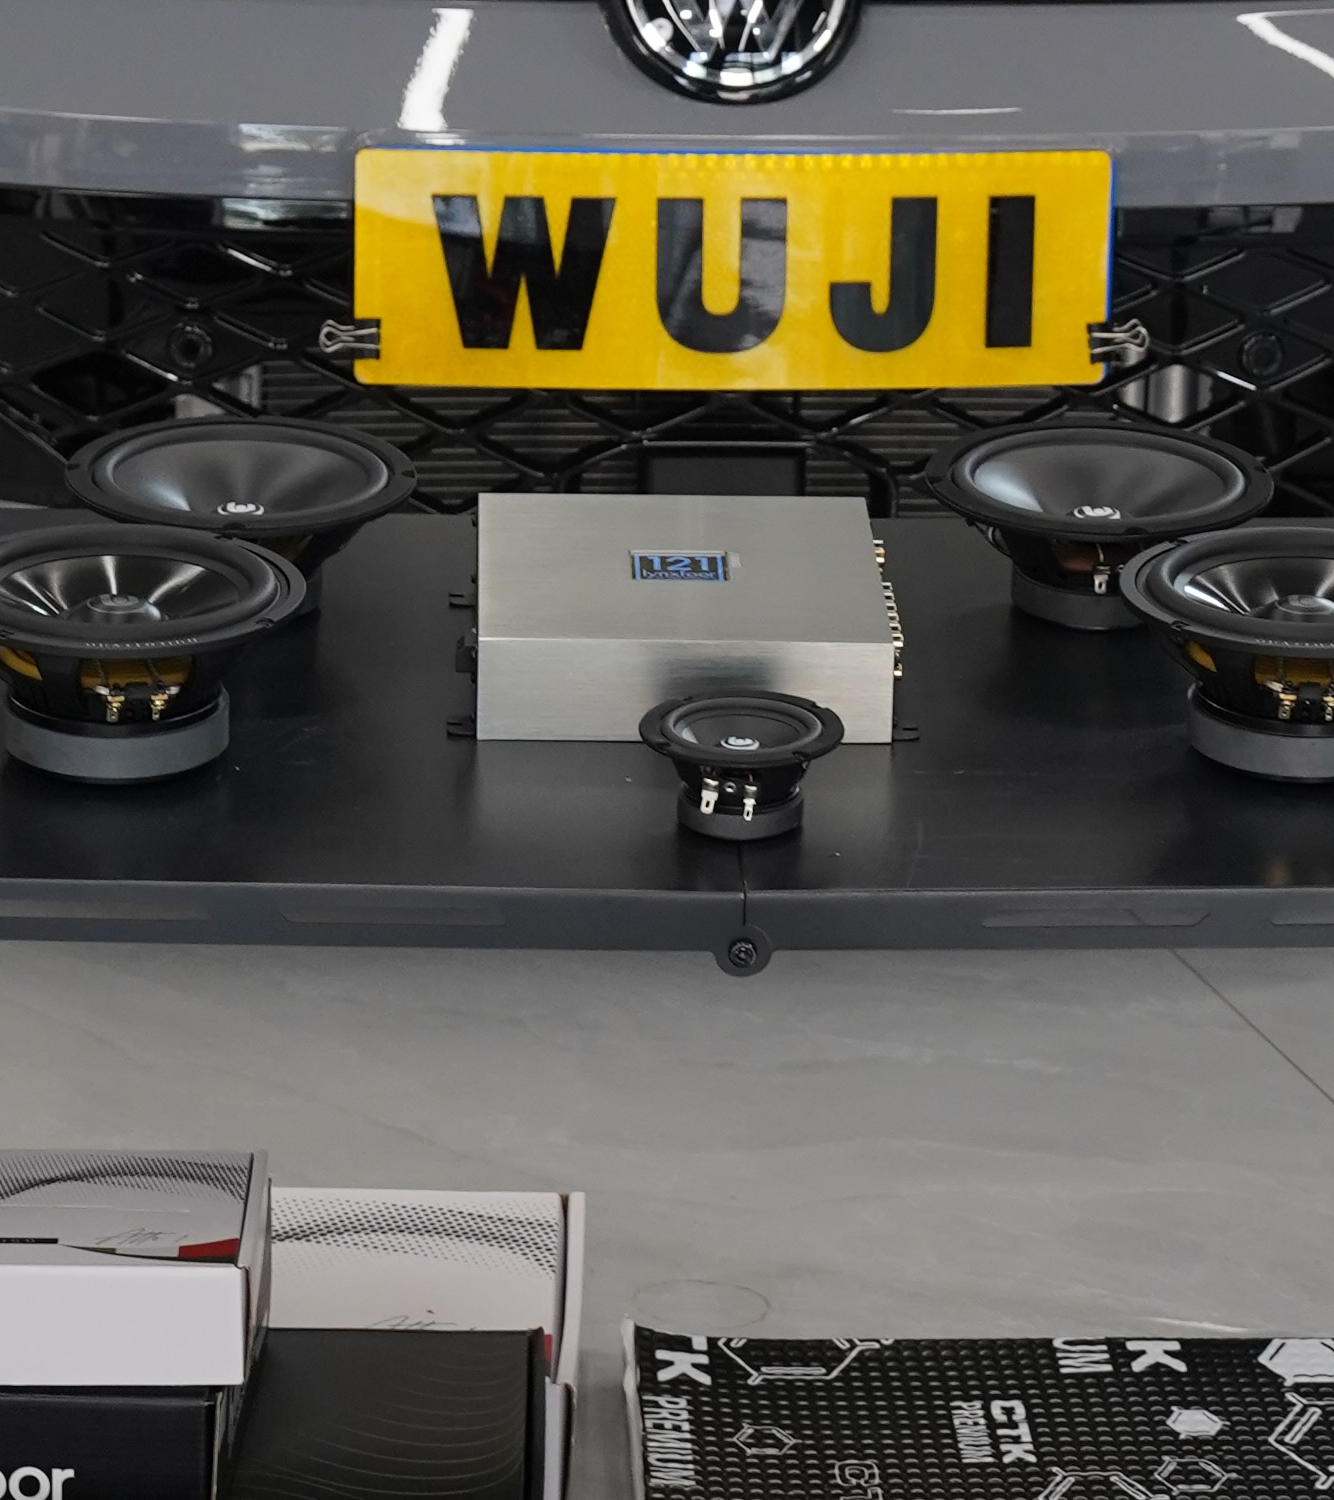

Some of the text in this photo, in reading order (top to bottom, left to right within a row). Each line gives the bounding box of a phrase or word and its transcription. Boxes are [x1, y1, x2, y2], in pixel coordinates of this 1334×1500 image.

[431, 193, 1037, 354] WUJI
[642, 1395, 697, 1486] PREMIUM
[950, 1400, 995, 1464] PREMIUM
[990, 1399, 1037, 1464] CTK
